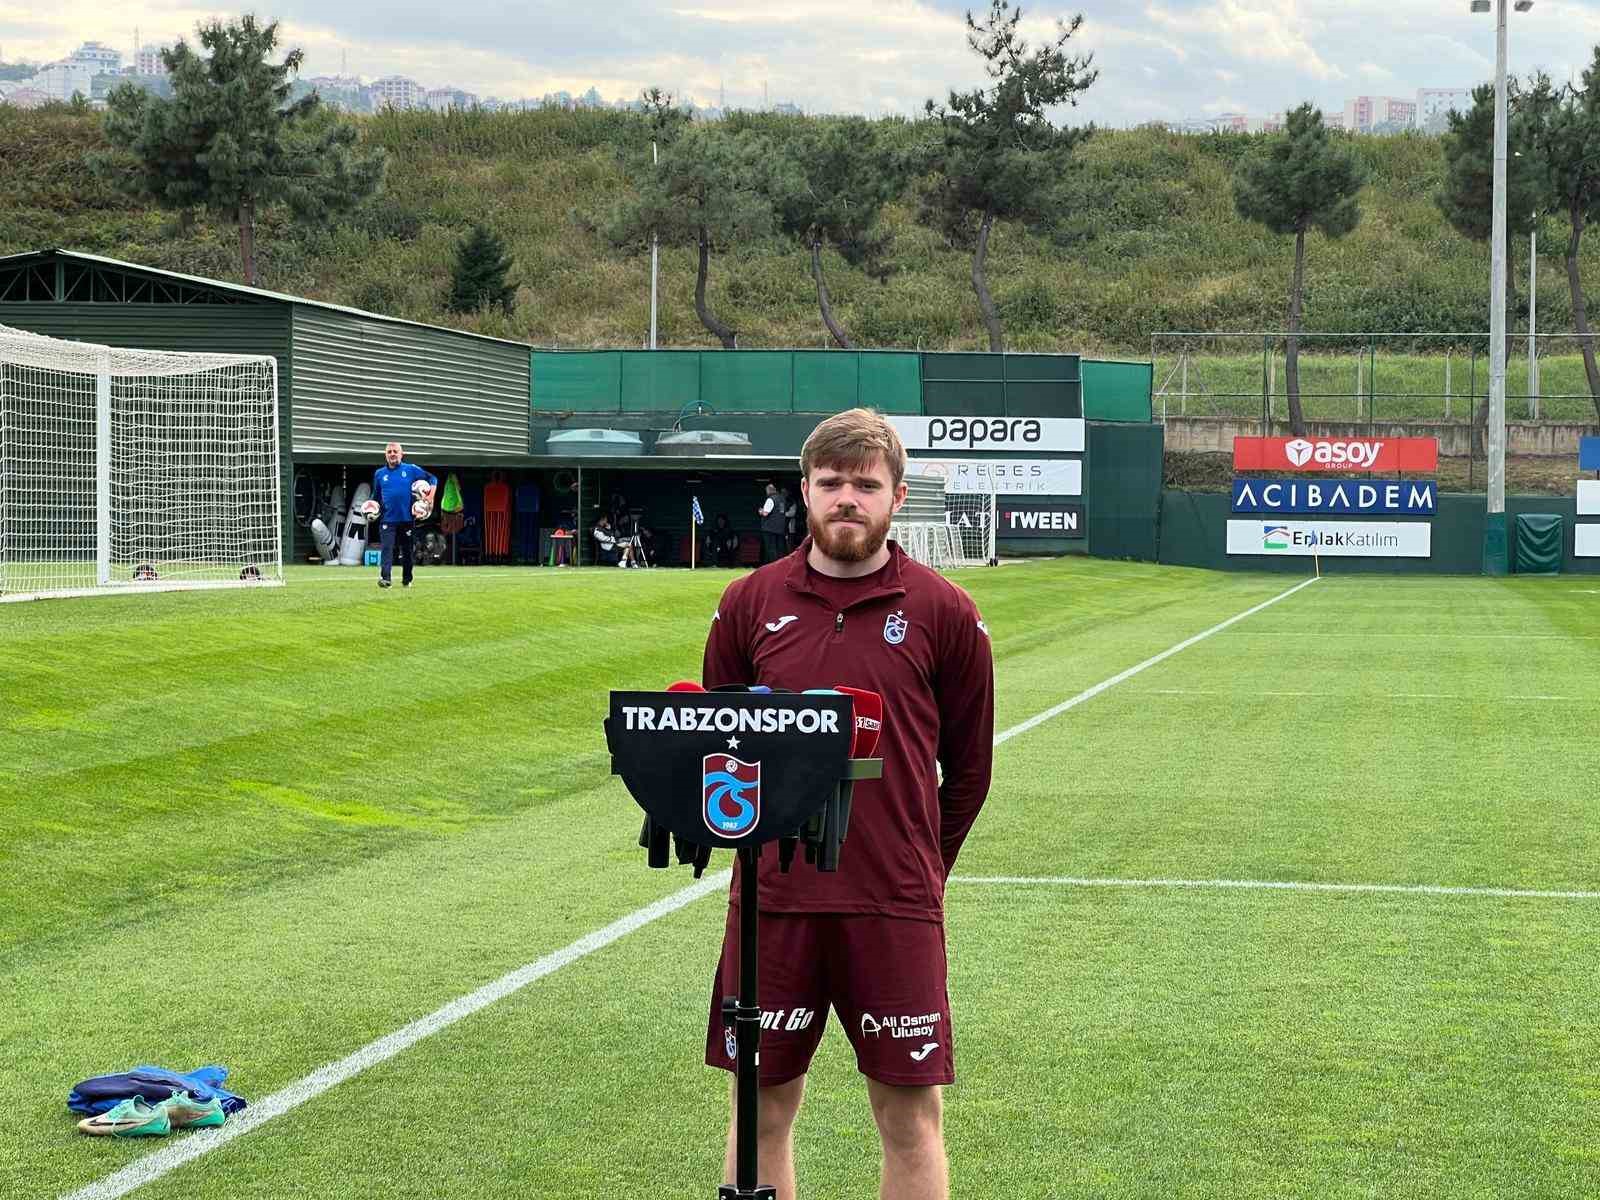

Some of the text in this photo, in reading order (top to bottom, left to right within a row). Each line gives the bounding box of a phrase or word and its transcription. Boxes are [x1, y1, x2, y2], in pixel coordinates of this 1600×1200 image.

[928, 418, 1041, 448] papara
[1314, 441, 1380, 468] asoy
[953, 481, 1047, 490] ELETRIK
[1236, 484, 1433, 509] ACIBADEM
[1004, 511, 1077, 530] TWEEN
[622, 706, 840, 734] TRABZONSPOR
[759, 1007, 815, 1031] nt Go
[892, 1024, 935, 1038] Ulusoy
[900, 1012, 941, 1027] Osman
